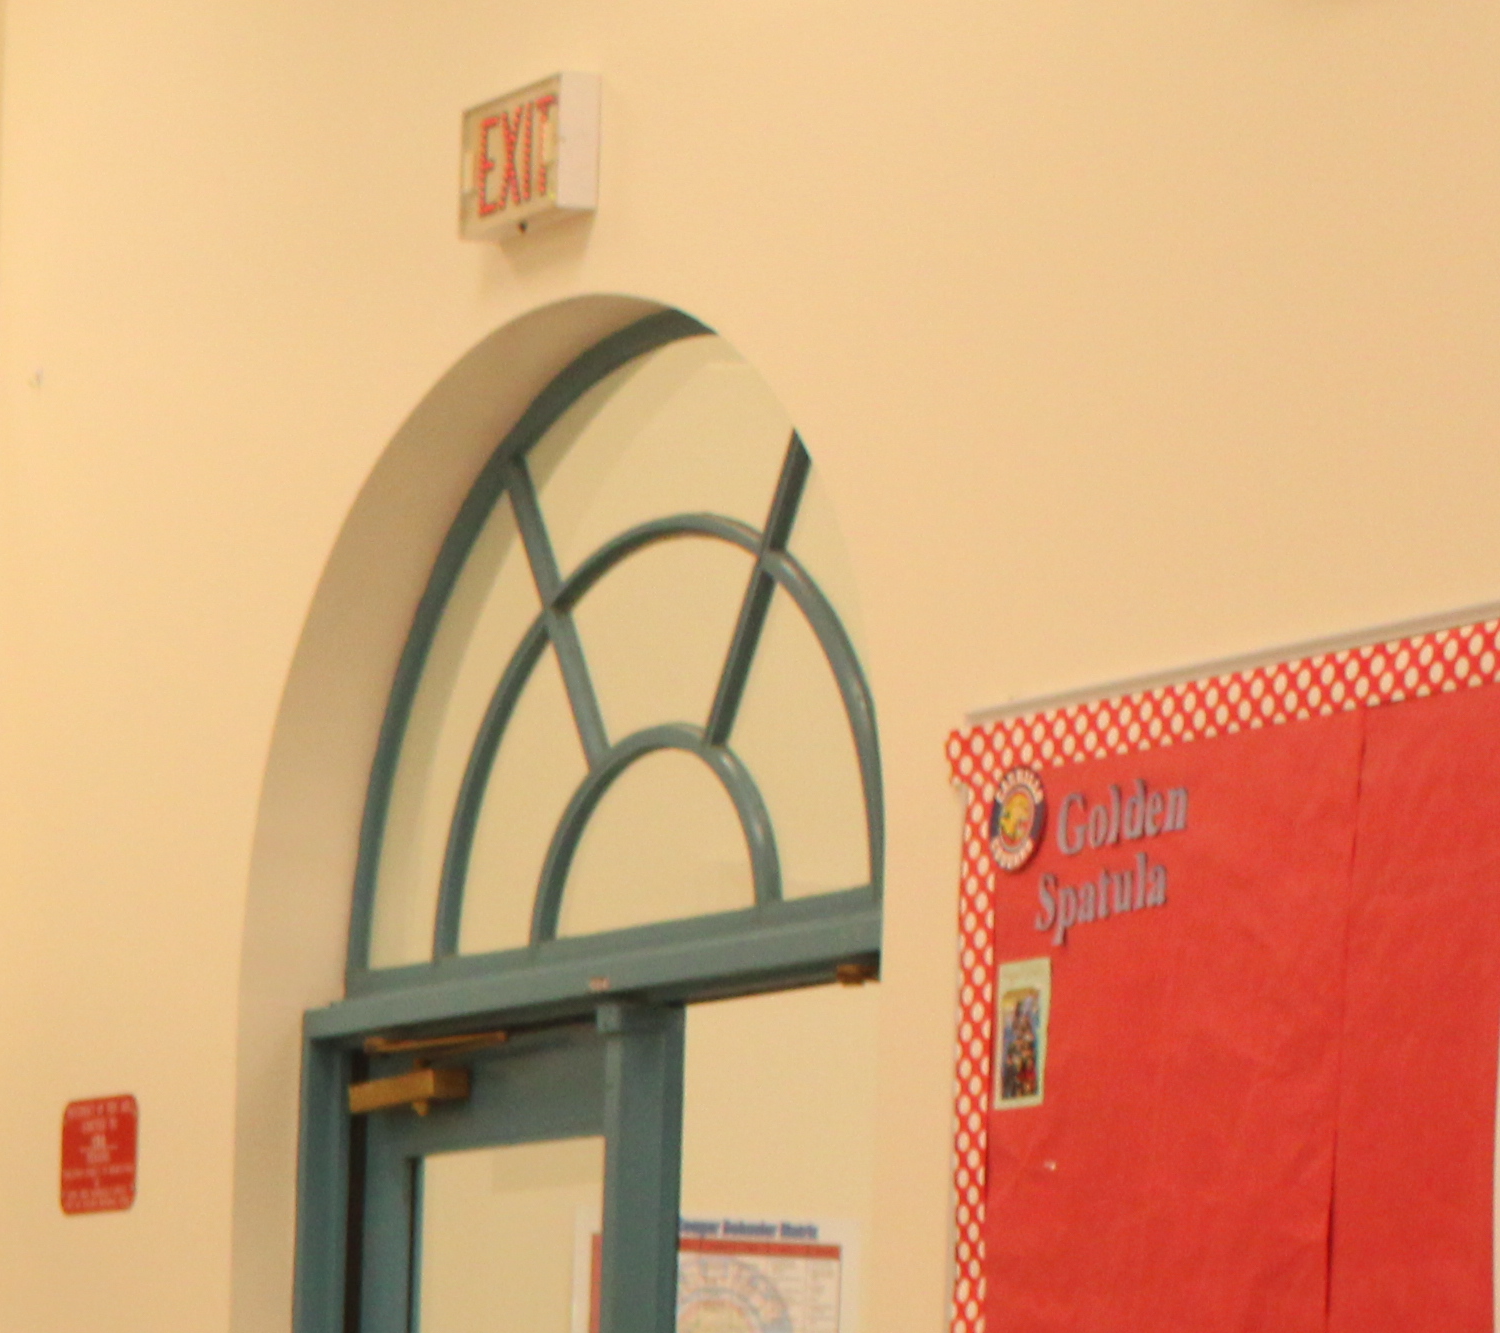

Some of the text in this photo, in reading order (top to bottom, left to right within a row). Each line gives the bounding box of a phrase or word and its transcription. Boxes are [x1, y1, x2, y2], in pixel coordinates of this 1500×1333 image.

[479, 94, 557, 216] EXIT
[1057, 778, 1189, 856] Golden
[1034, 851, 1168, 946] Spatula
